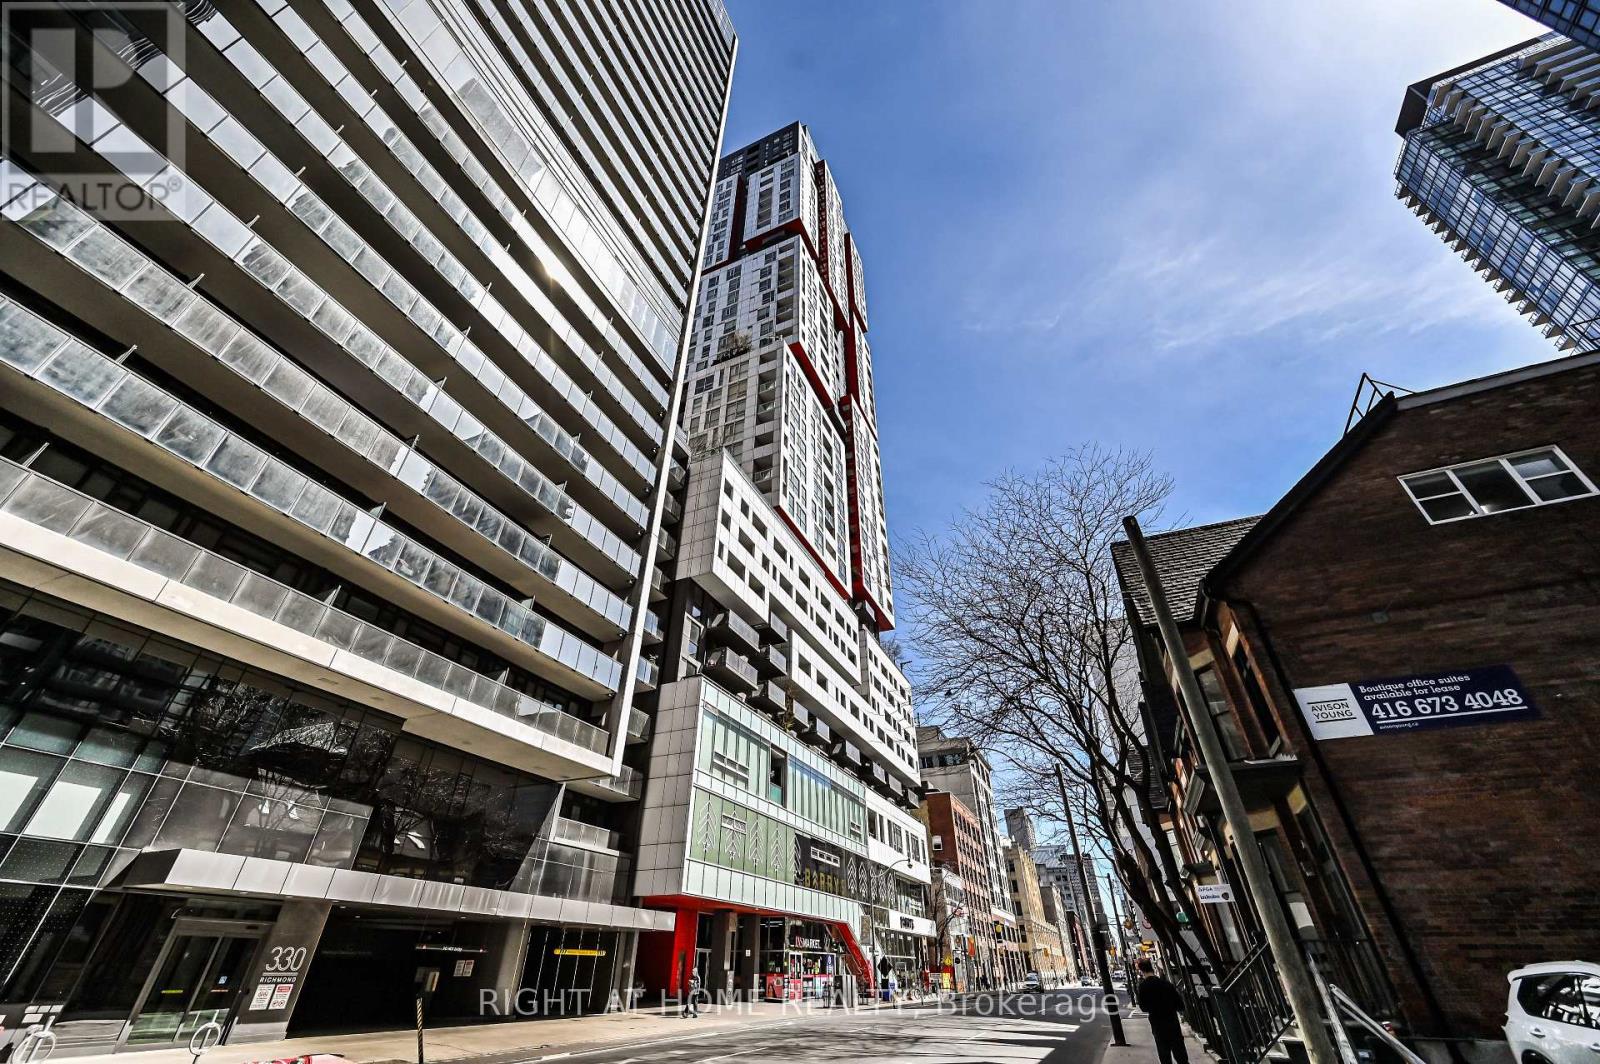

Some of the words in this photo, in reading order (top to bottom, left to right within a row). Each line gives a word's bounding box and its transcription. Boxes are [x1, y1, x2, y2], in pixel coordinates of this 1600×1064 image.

[1359, 683, 1405, 693] Boutique
[1406, 679, 1436, 688] office
[1437, 675, 1471, 684] suites
[1363, 689, 1412, 700] available
[1413, 687, 1429, 695] for
[1430, 685, 1461, 693] lease
[1311, 701, 1350, 712] AVISON
[1372, 700, 1412, 719] 416
[1414, 695, 1459, 714] 673
[1464, 688, 1523, 709] 4048
[1313, 709, 1353, 720] YOUNG
[265, 946, 307, 972] 330
